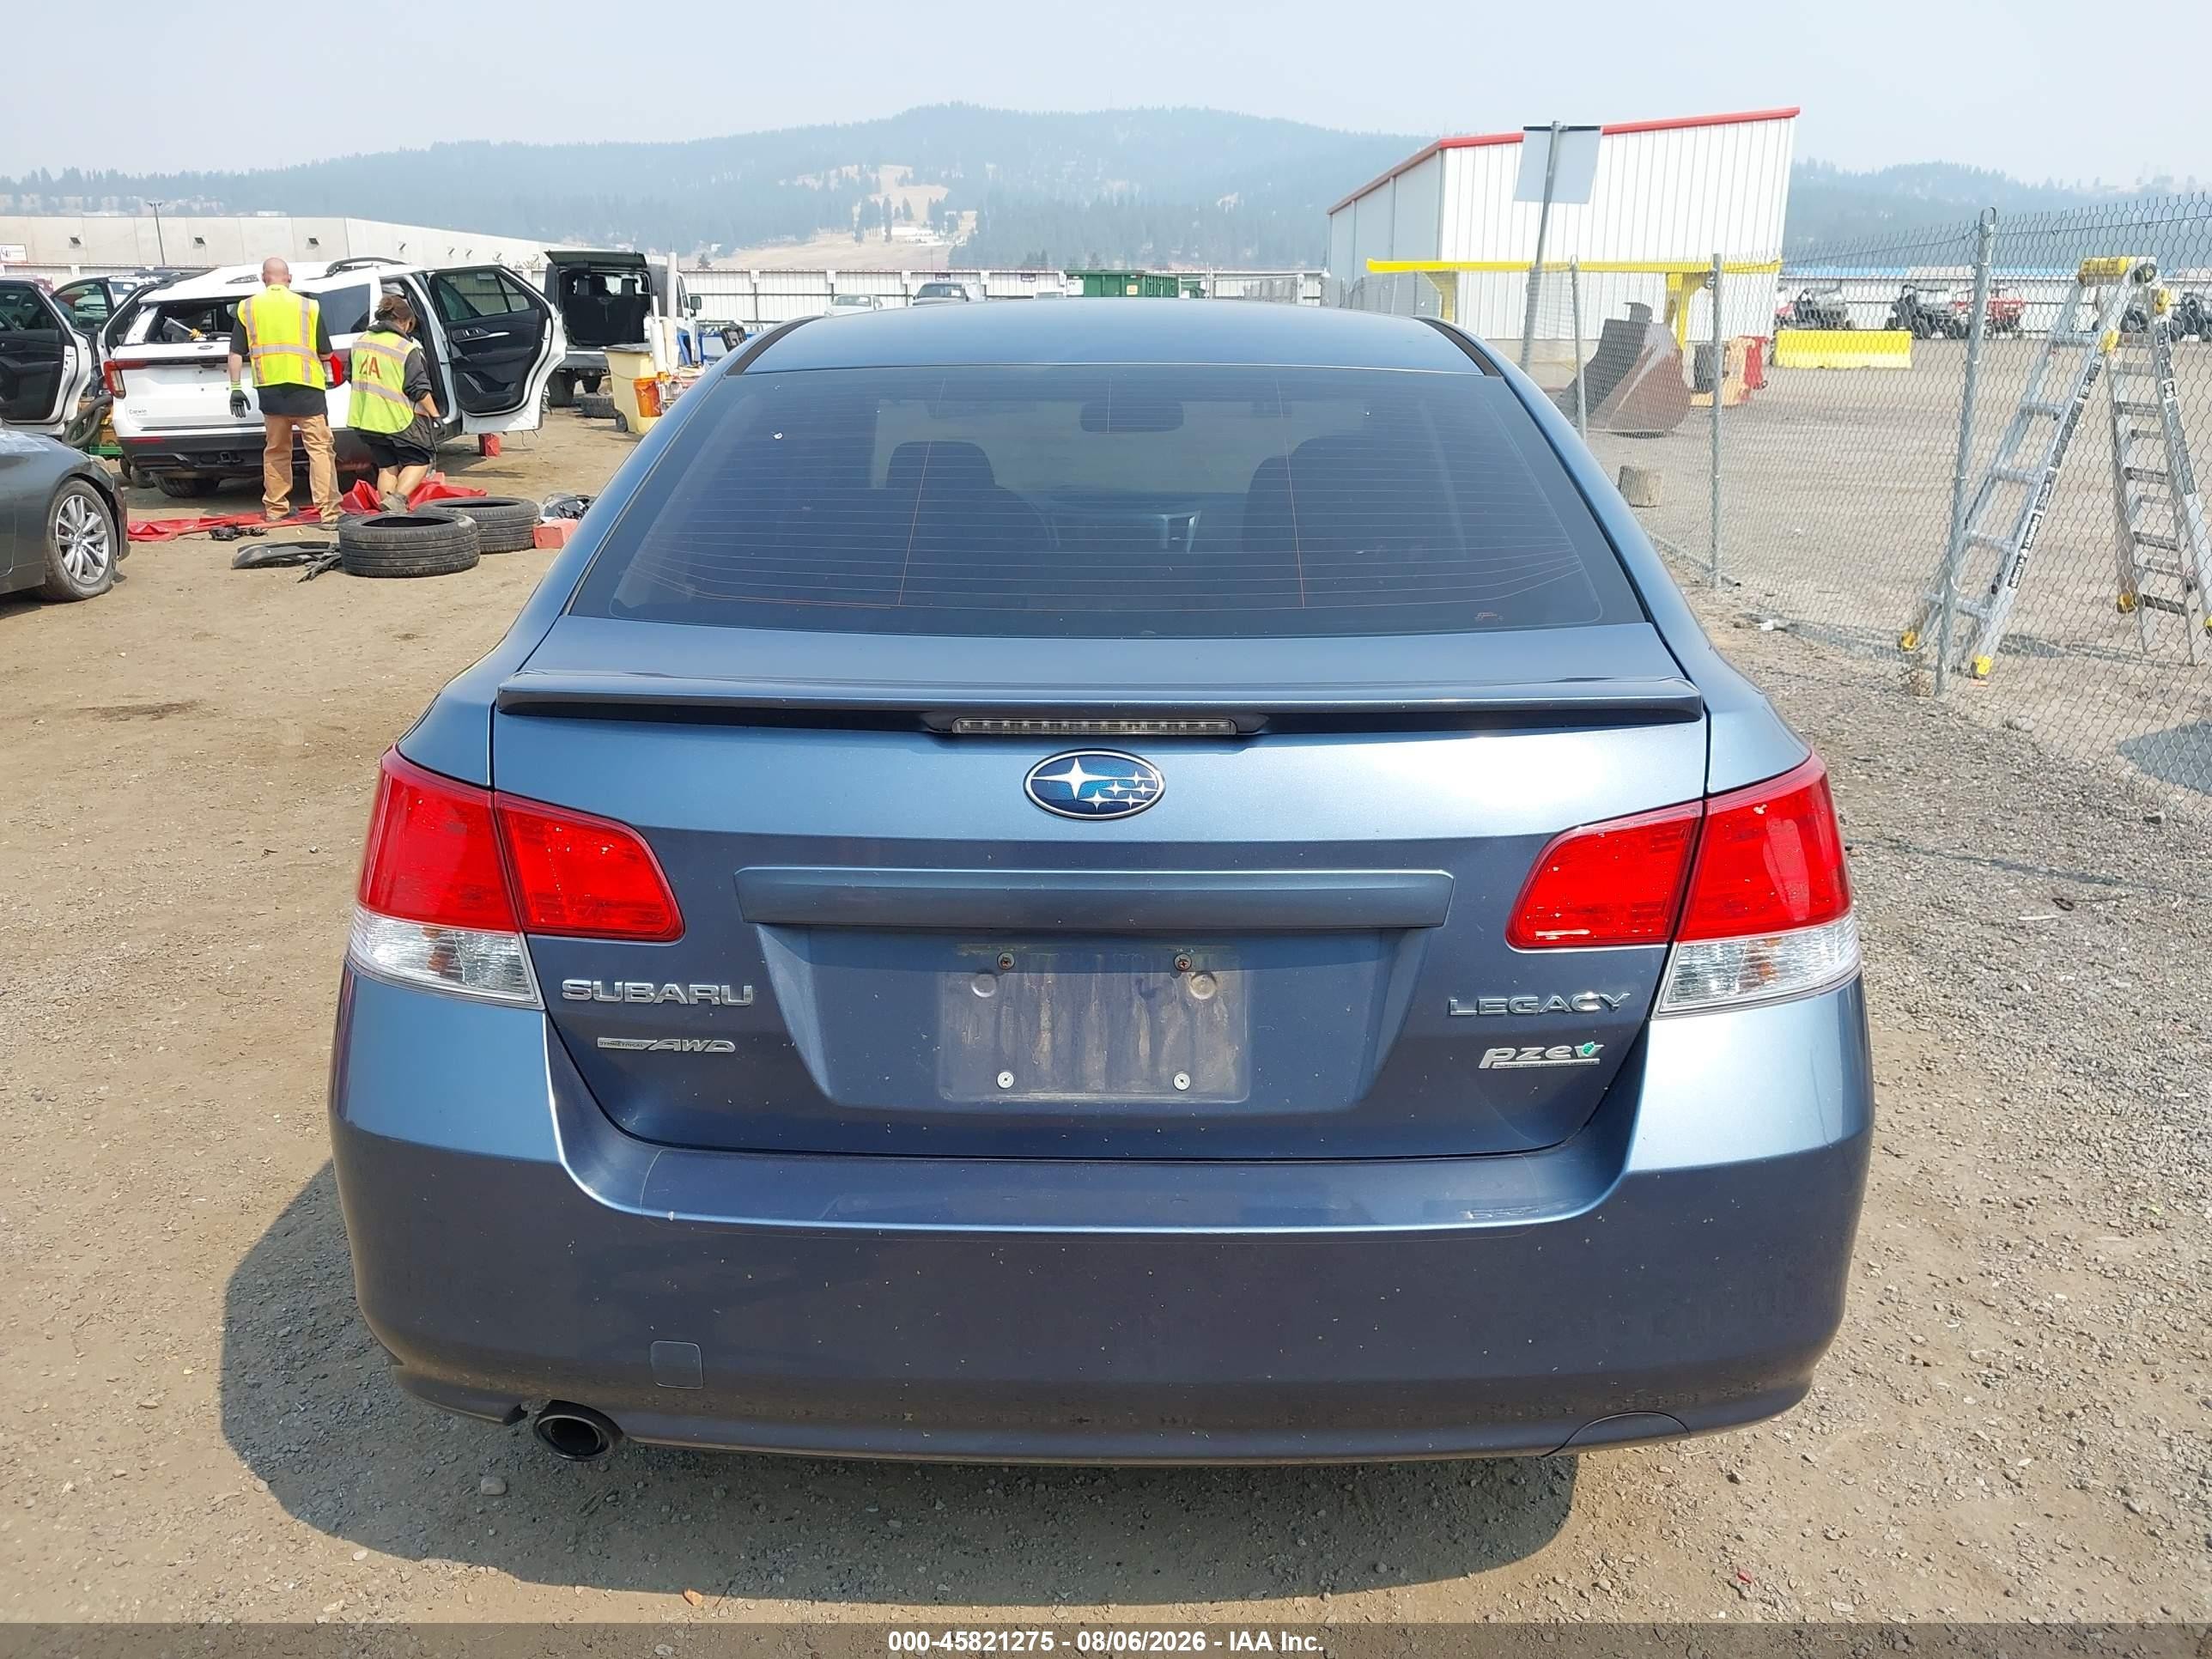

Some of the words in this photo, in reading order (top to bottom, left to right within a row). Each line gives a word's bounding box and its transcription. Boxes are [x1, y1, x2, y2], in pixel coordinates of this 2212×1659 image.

[562, 979, 753, 1006] SUBARU
[1449, 992, 1631, 1016] LEGACY
[647, 1039, 736, 1053] AWD
